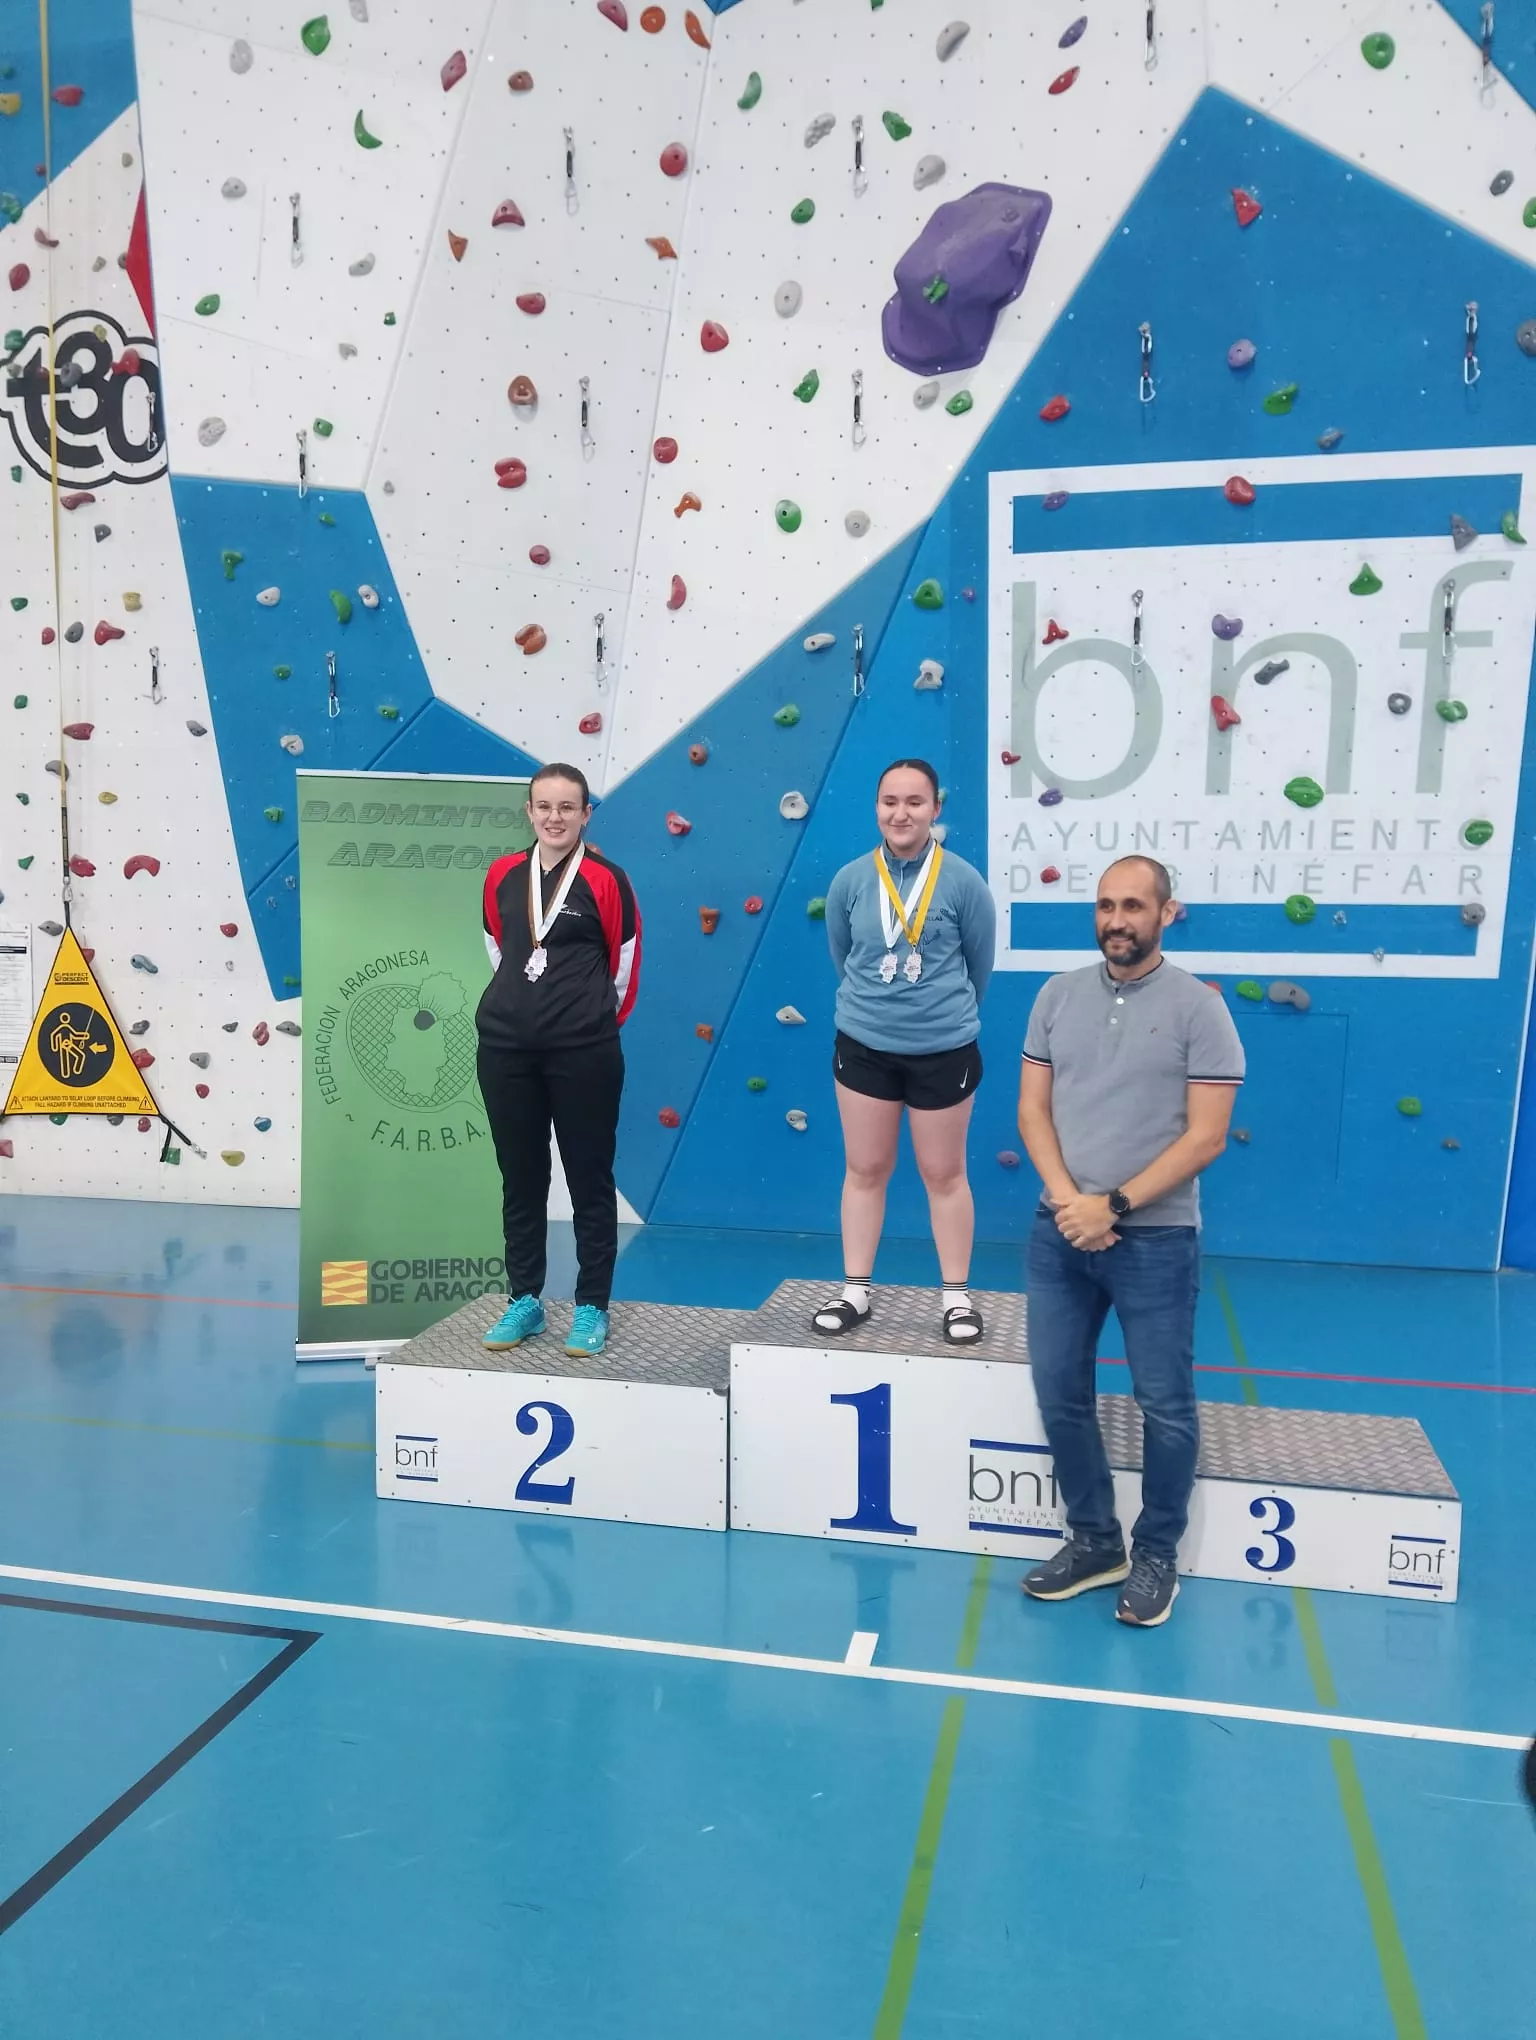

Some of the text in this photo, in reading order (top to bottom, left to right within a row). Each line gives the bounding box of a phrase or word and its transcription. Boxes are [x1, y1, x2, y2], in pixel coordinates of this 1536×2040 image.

[1010, 560, 1514, 800] bnf
[1009, 864, 1089, 894] DE
[338, 950, 430, 1000] ARAGONESA
[315, 1005, 342, 1105] FEDERACION
[371, 1257, 505, 1281] GOBIERNO
[371, 1279, 511, 1304] DE ARAGO
[395, 1442, 439, 1469] bnf
[515, 1401, 575, 1505] 2
[830, 1383, 917, 1536] 1
[1245, 1496, 1297, 1573] 3
[1389, 1543, 1446, 1574] bnf
